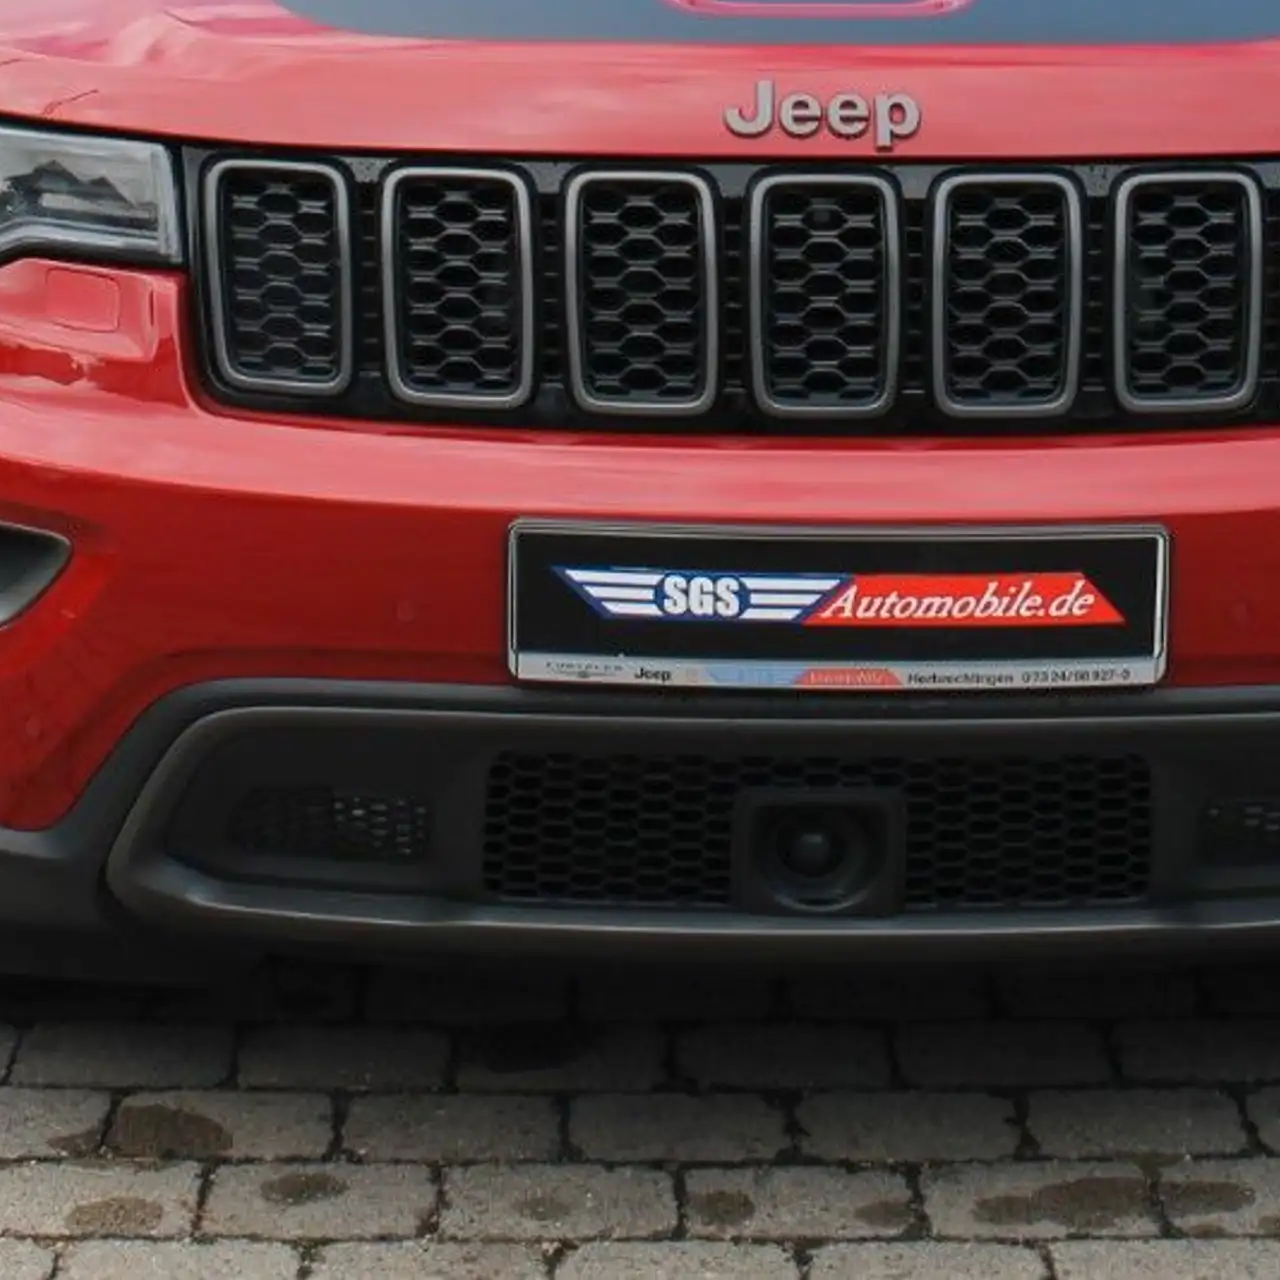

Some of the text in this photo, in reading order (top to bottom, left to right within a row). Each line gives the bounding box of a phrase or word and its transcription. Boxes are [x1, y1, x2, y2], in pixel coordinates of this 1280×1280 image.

[722, 79, 922, 153] Jeep
[663, 575, 1096, 619] SGS Automobile.de
